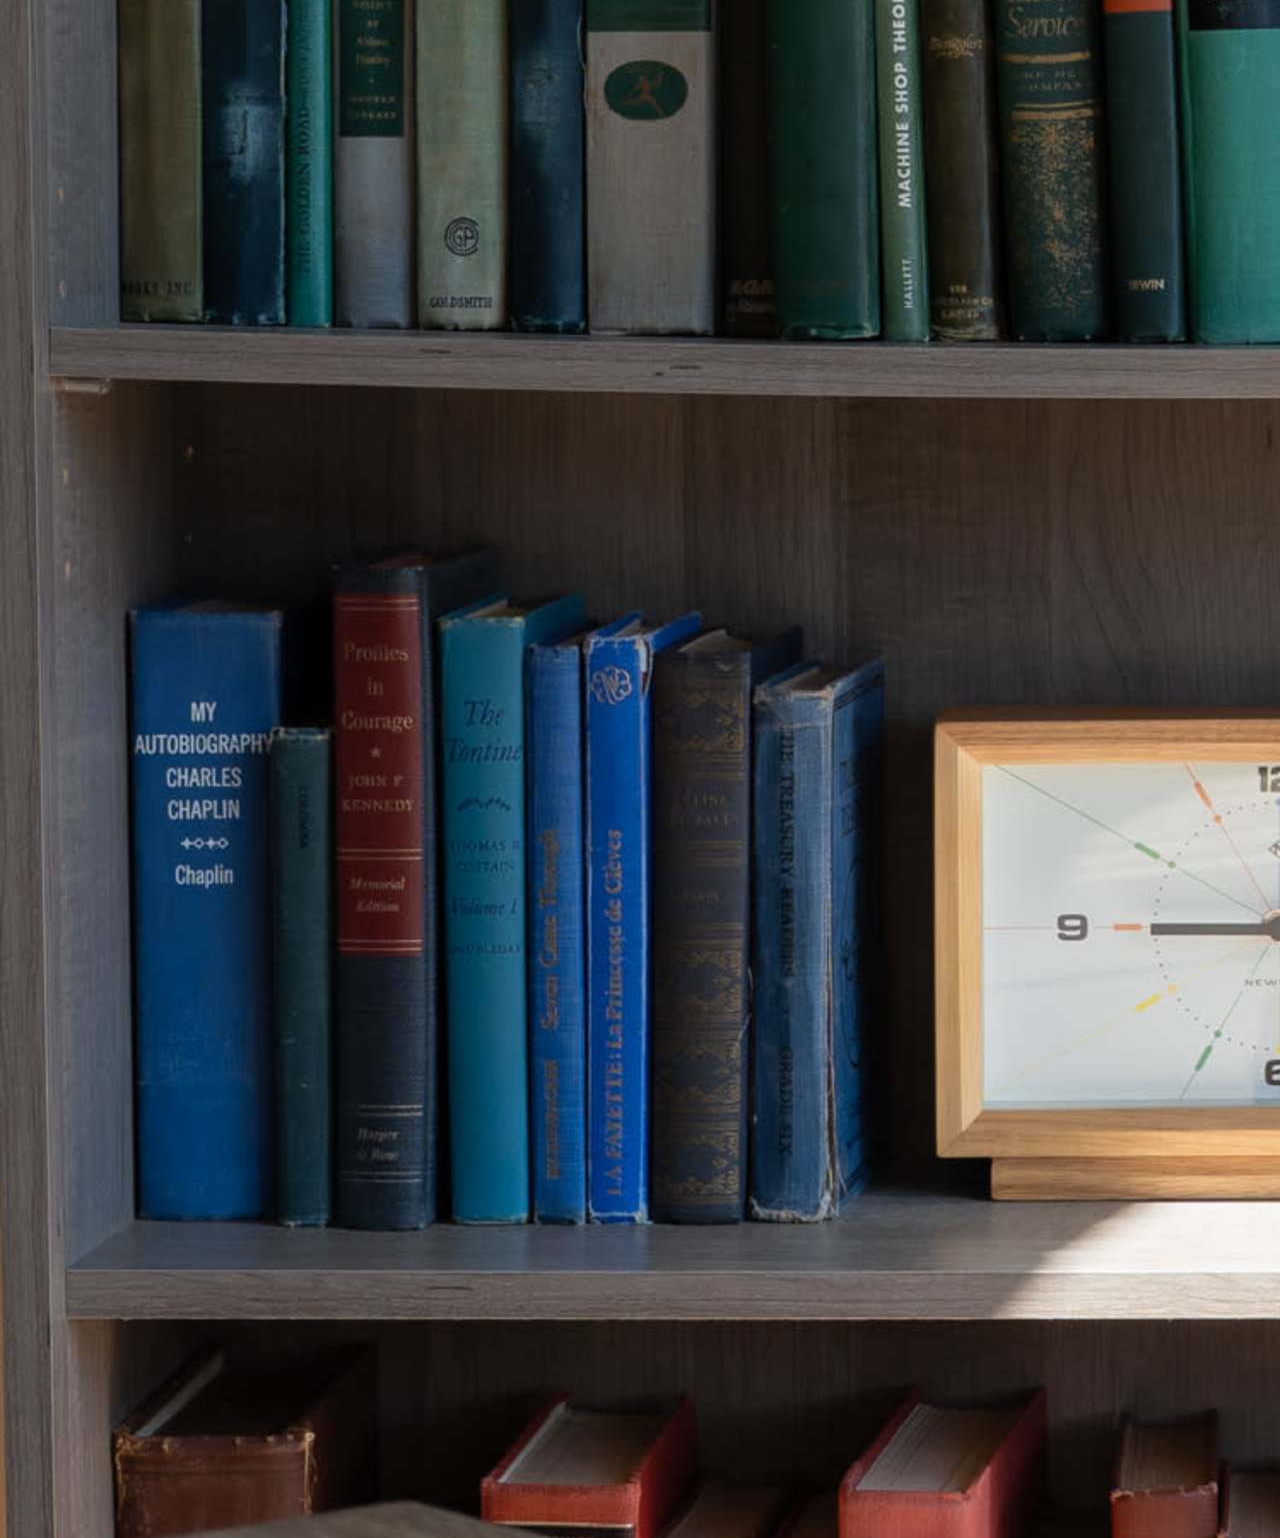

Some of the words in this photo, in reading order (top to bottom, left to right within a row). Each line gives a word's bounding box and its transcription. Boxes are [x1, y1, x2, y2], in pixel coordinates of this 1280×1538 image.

[892, 62, 909, 114] SHOP
[895, 119, 916, 211] MACHINE
[430, 297, 492, 308] GOLDSMITH
[367, 679, 384, 695] in
[190, 702, 217, 722] MY
[341, 710, 417, 733] Courage
[464, 700, 504, 727] The
[135, 732, 273, 755] AUTOBIOGRAPHY
[445, 736, 523, 763] Tontine
[166, 766, 243, 789] CHARLES
[349, 775, 387, 789] JOHN
[167, 799, 241, 820] CHAPLIN
[342, 798, 414, 813] KENNEDY
[604, 829, 623, 894] Clèves
[175, 864, 235, 888] Chaplin
[604, 898, 622, 922] de
[1057, 914, 1088, 941] 9
[604, 923, 624, 1021] Princesse
[608, 1022, 624, 1049] La
[606, 1050, 624, 1159] FAYETTE:
[607, 1164, 624, 1195] LA
